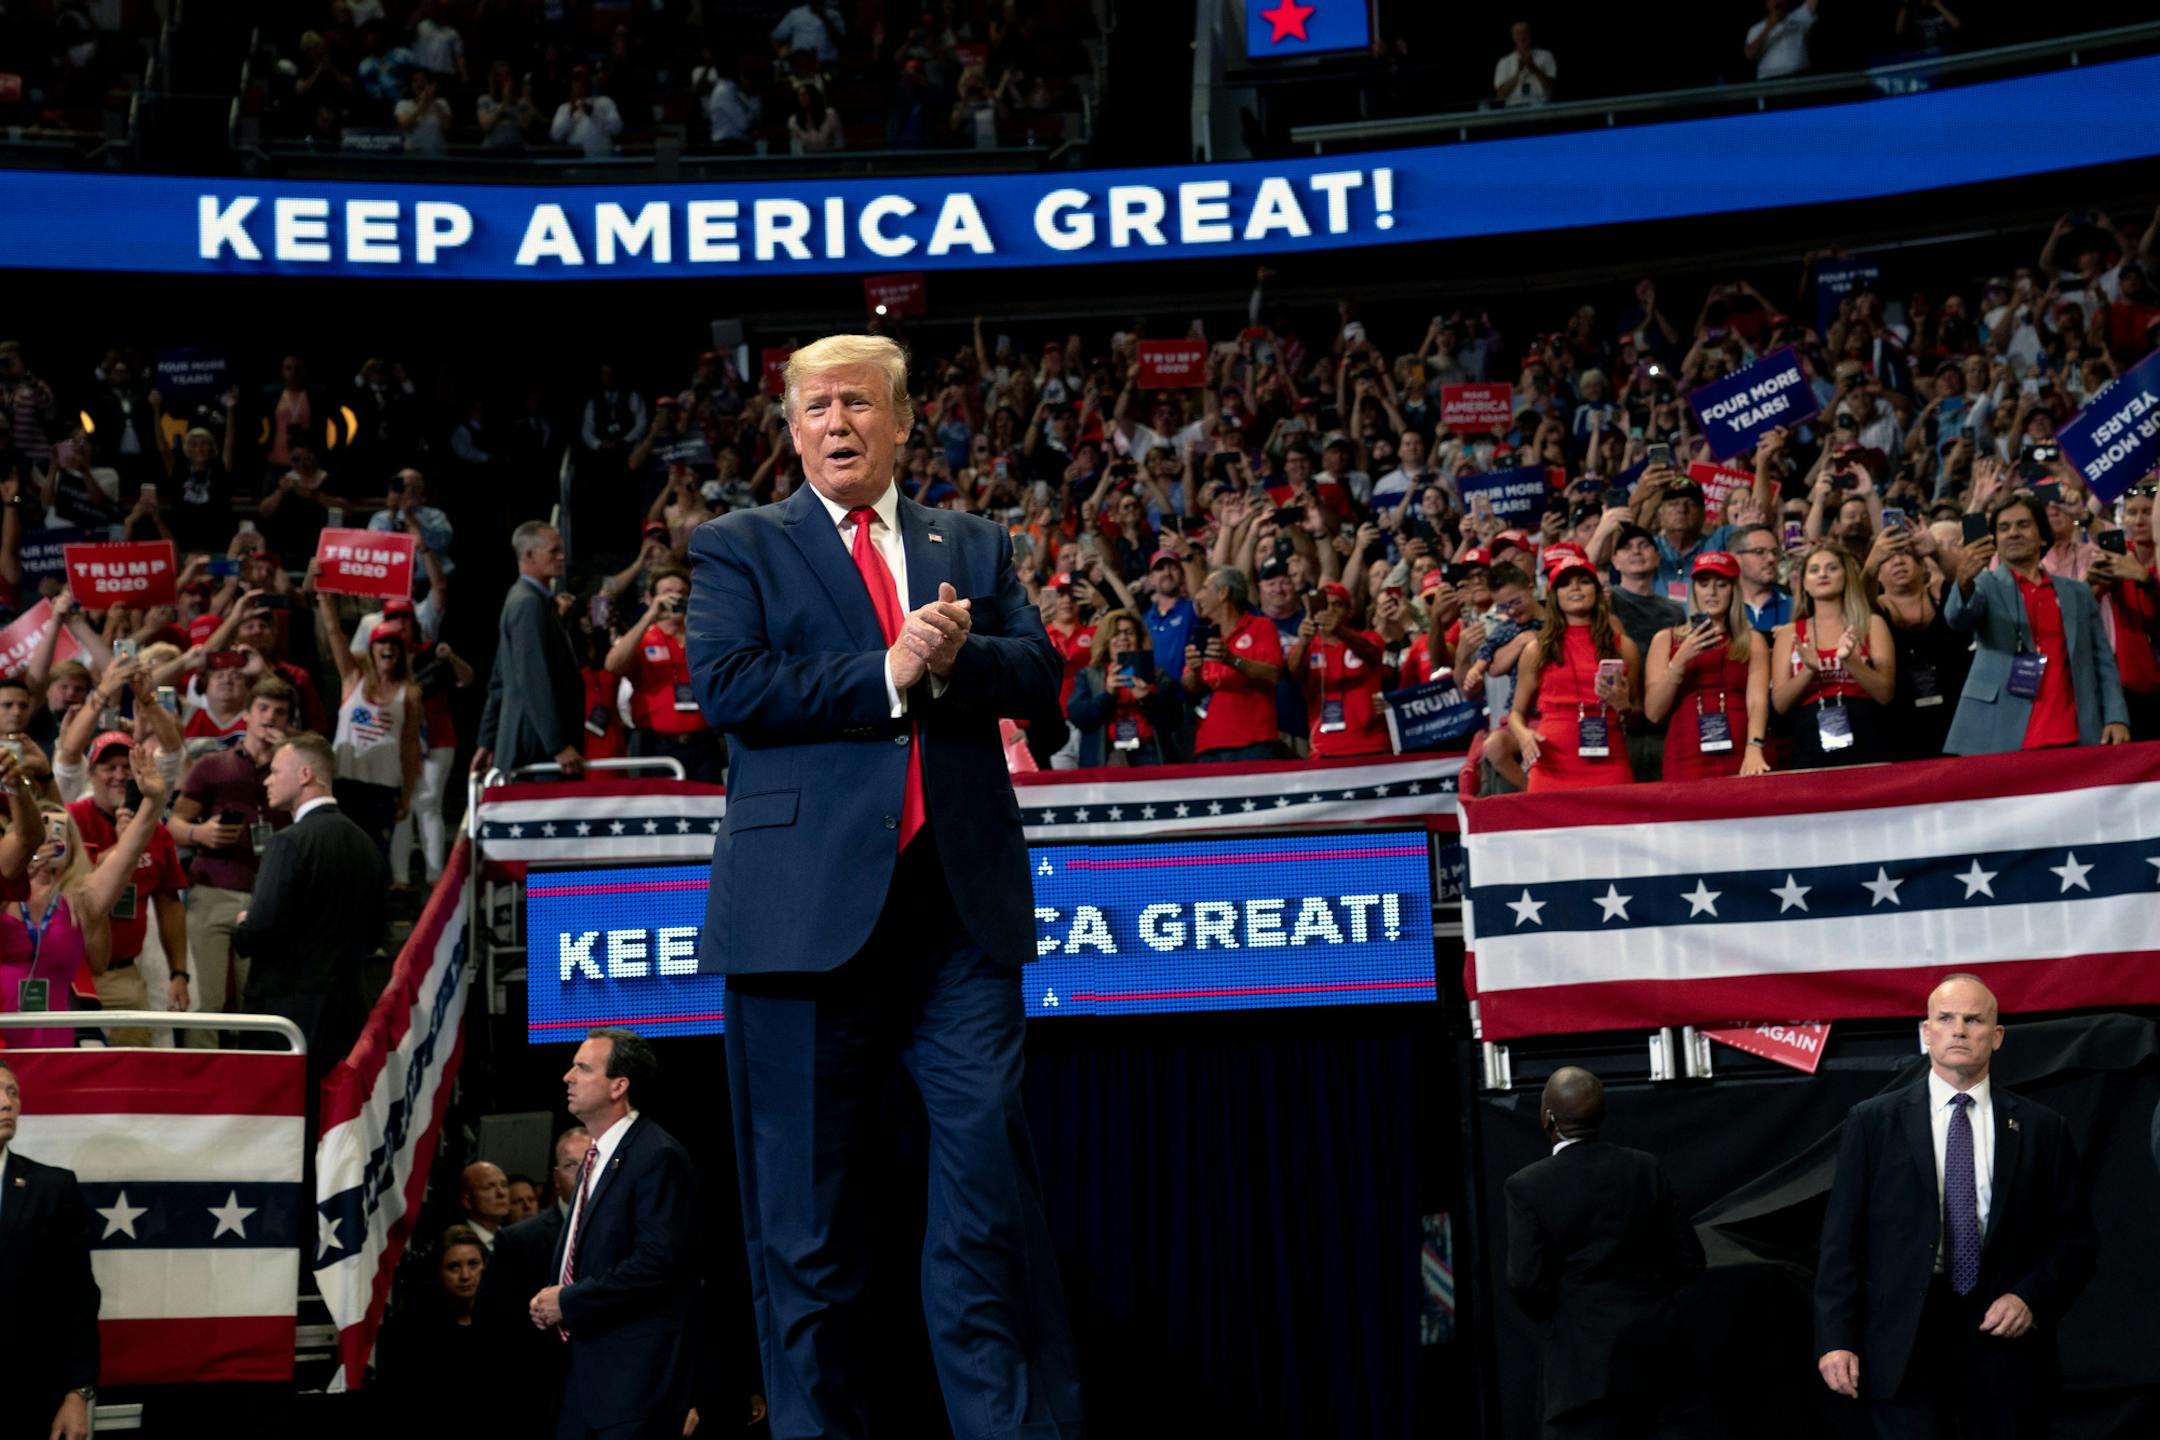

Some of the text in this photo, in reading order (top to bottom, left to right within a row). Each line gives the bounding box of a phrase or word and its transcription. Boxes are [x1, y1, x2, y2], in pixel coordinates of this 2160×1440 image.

[200, 168, 1393, 265] KEEP AMERICA GREAT!
[1142, 352, 1202, 365] TRUMP
[1445, 400, 1509, 413] AMERICA
[1700, 366, 1802, 425] FOUR MORE
[1726, 394, 1791, 433] YEARS!
[2089, 389, 2160, 448] YEARS!
[2083, 431, 2142, 482] MORE
[1504, 481, 1545, 497] MORE
[1492, 498, 1532, 514] EARS!
[325, 545, 407, 566] TRUMP
[73, 559, 168, 577] TRUMP
[338, 560, 388, 578] 2020
[95, 577, 149, 592] 2020
[1400, 687, 1462, 719] TRUM
[559, 926, 699, 981] KEE
[1138, 893, 1401, 952] GREAT!
[1755, 1025, 1818, 1053] AGAIN
